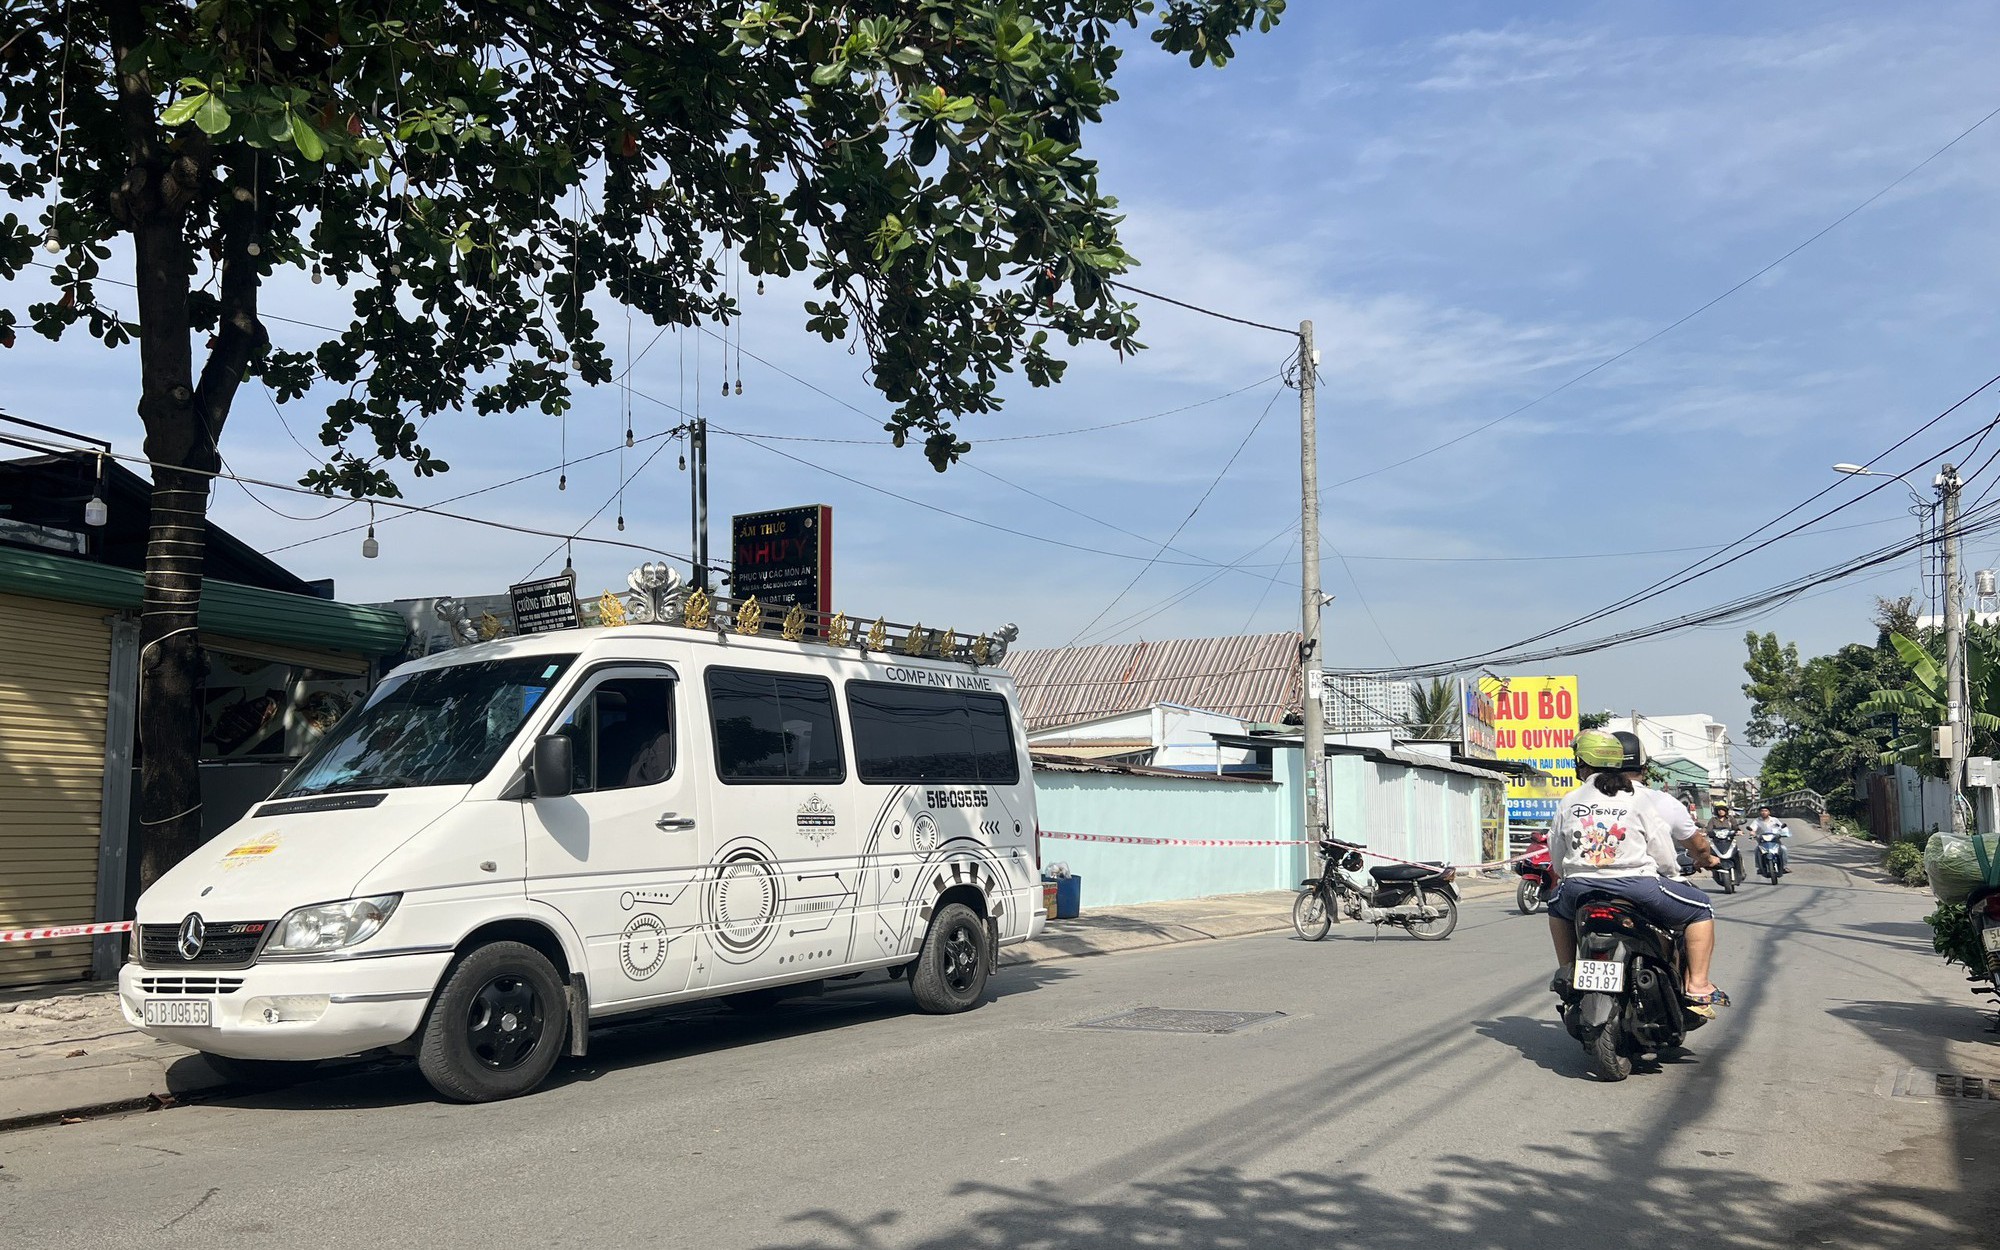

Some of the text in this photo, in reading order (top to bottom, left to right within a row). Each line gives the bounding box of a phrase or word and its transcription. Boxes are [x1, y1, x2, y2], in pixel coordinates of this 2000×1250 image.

[761, 521, 786, 536] THỰC
[739, 538, 788, 565] NHƯ
[739, 572, 757, 582] PHỤC
[759, 571, 768, 581] VỤ
[769, 568, 783, 578] CÁC
[517, 589, 571, 612] CƯỜNG TIẾN THỌ
[782, 593, 796, 603] TIỆC
[885, 667, 992, 691] COMPANY NAME
[1538, 686, 1572, 720] BÒ
[1521, 726, 1574, 750] QUỲNH
[1539, 758, 1554, 769] RAU
[1556, 757, 1576, 769] RỪNG
[1552, 776, 1573, 787] CHI
[926, 790, 989, 809] 51B-095.55
[1507, 799, 1538, 808] 09194
[1583, 962, 1616, 976] 59-X3
[1578, 975, 1618, 989] 851.87
[146, 1002, 208, 1024] 51B-095.55
